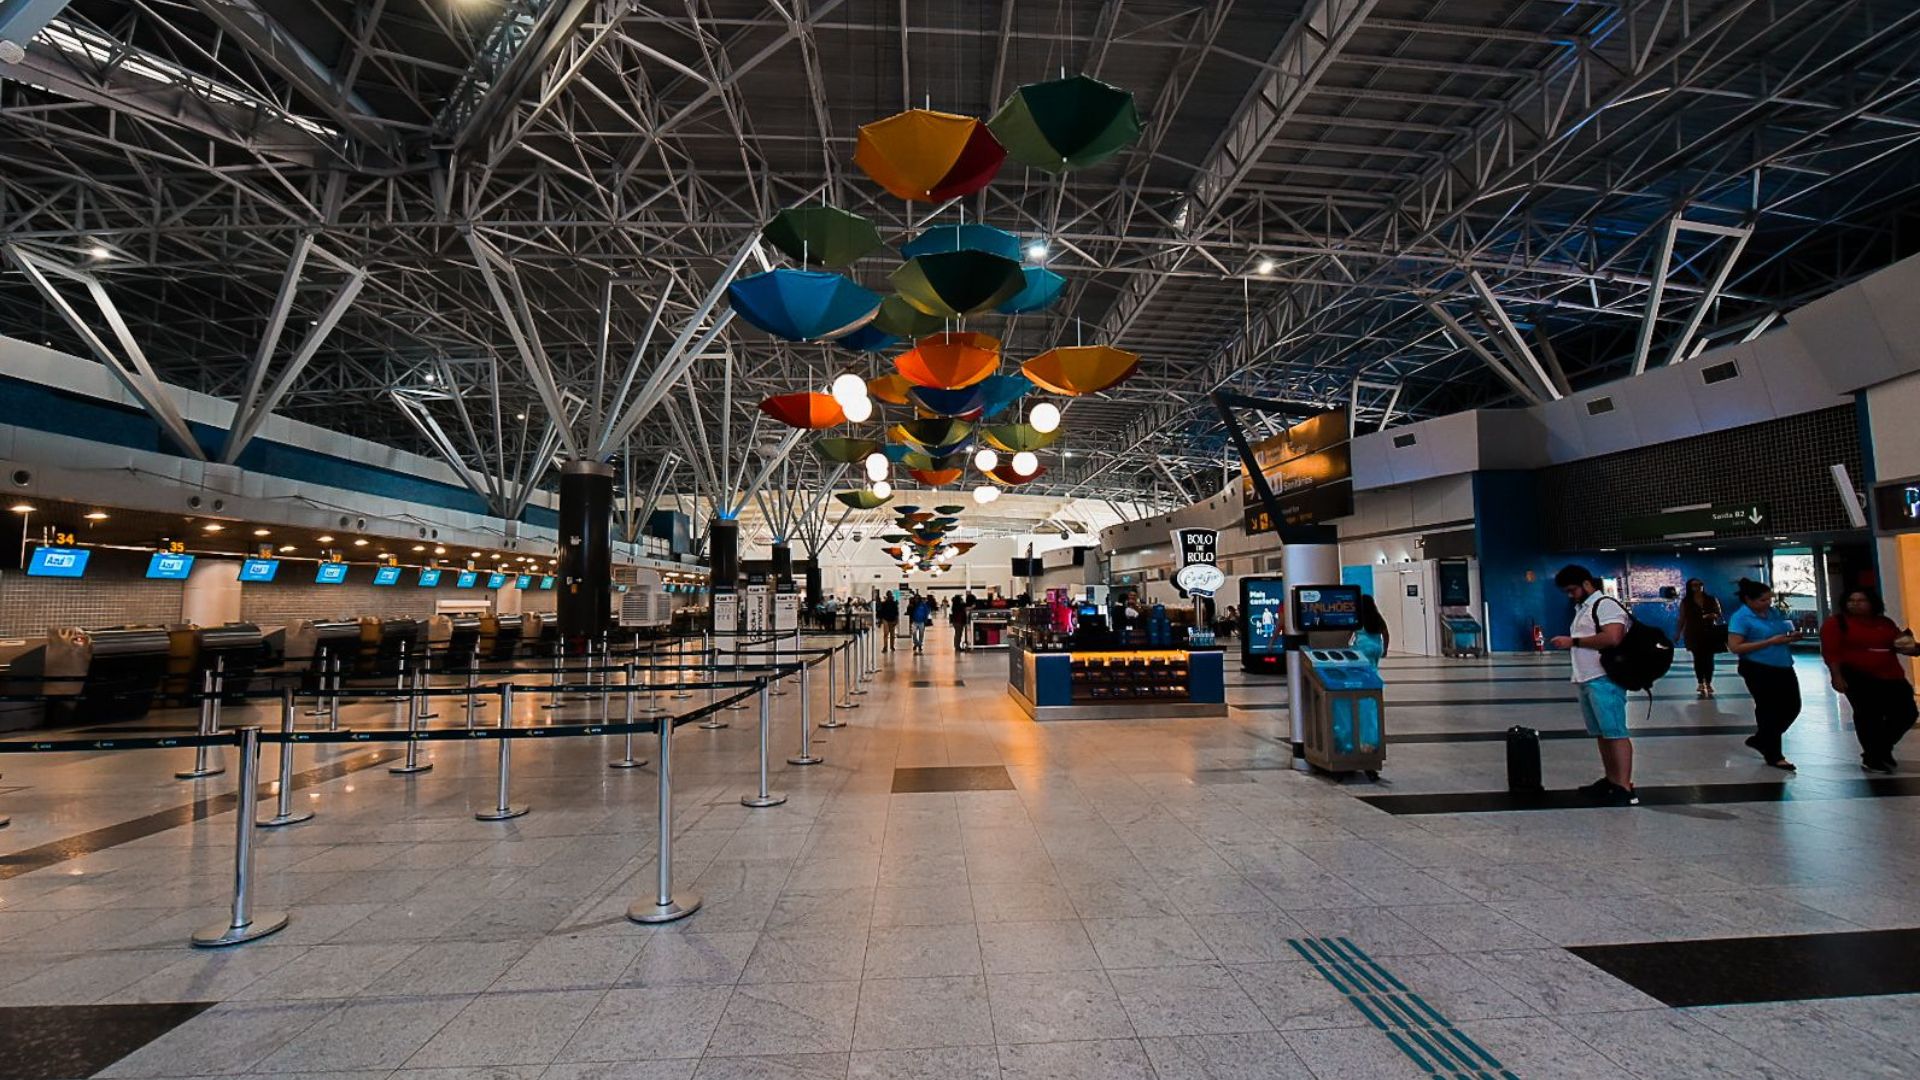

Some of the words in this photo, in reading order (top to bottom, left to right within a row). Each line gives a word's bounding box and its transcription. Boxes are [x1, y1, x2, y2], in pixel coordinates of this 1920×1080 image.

[56, 532, 75, 545] 34
[1187, 534, 1213, 545] BOLO
[169, 541, 184, 553] 35
[1187, 552, 1214, 562] ROLO
[1249, 591, 1265, 600] Mais
[1249, 598, 1280, 606] conforto
